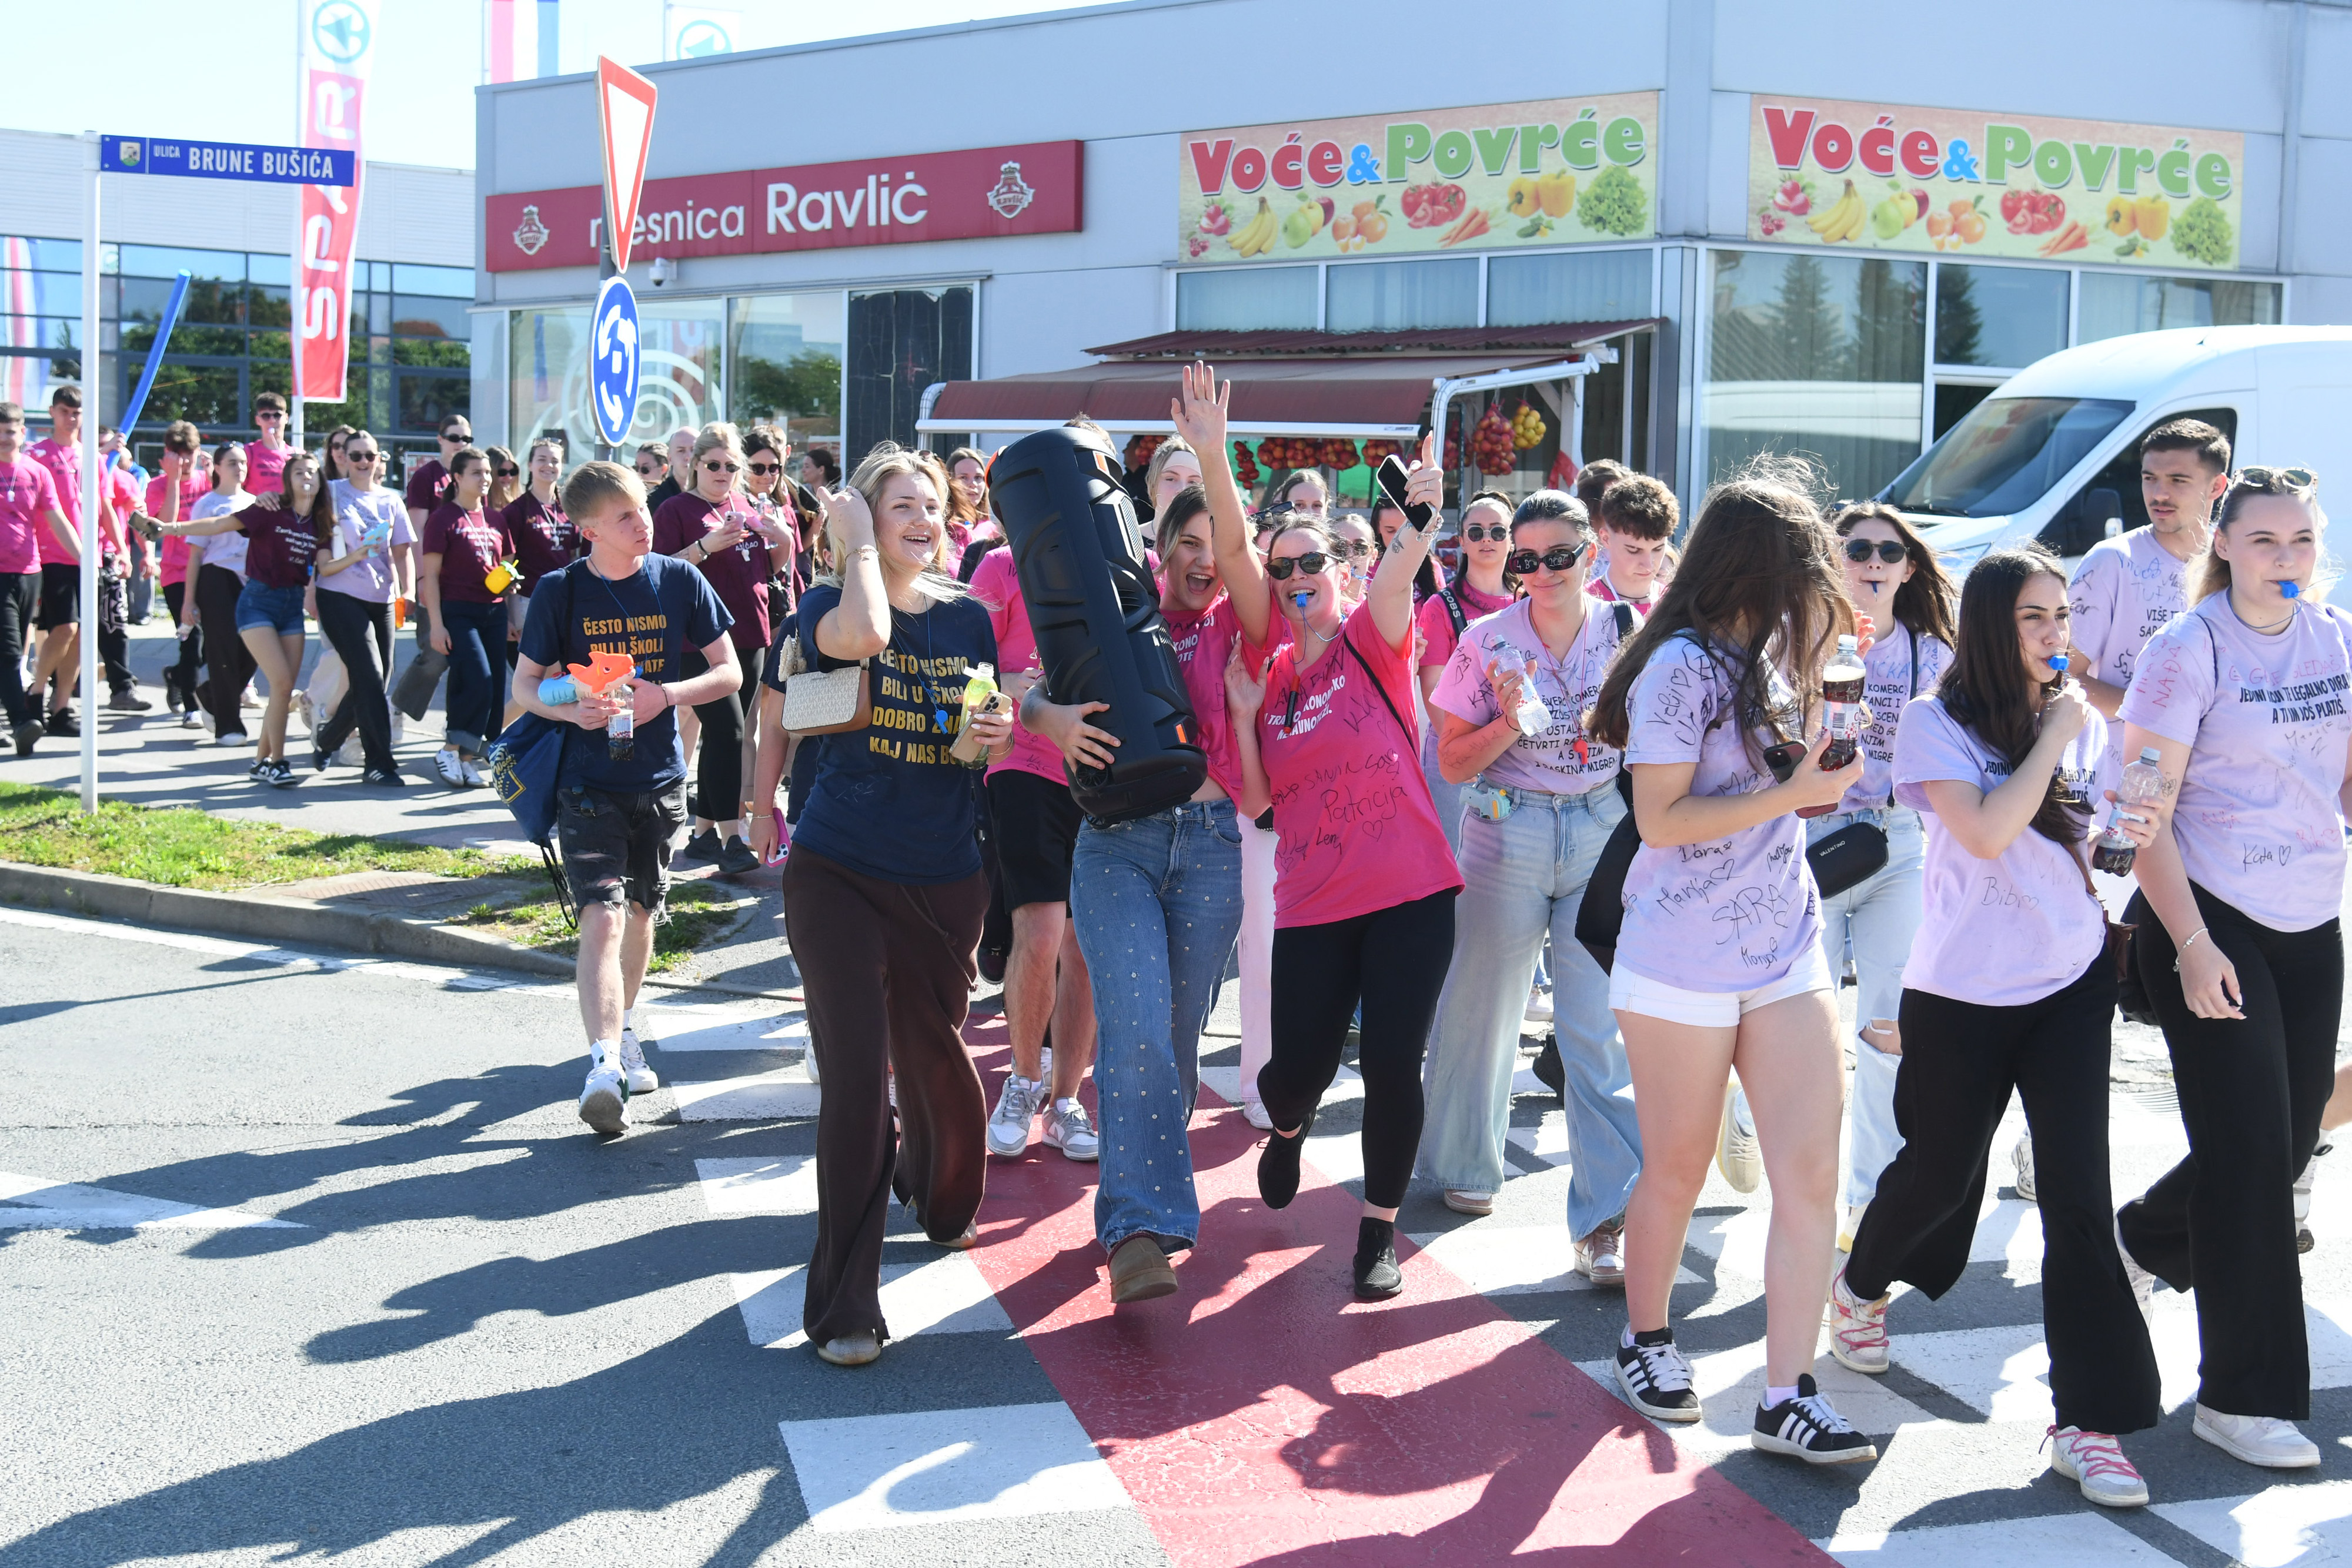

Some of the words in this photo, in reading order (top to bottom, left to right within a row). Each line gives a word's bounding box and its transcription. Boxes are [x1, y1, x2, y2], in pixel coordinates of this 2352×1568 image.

[153, 144, 181, 158] ULICA
[189, 147, 255, 173] BRUNE
[262, 149, 334, 179] BUŠIĆA
[301, 80, 356, 341] SPR
[1442, 589, 1461, 618] COBS
[2147, 606, 2167, 621] VIŠE
[583, 617, 623, 636] ČESTO
[626, 614, 667, 633] NISMO
[630, 636, 664, 656] ŠKOLI
[919, 656, 969, 677] NISMO
[881, 676, 908, 701] BILI
[911, 685, 923, 704] U
[2239, 687, 2267, 703] JEDINI
[2290, 680, 2328, 701] LEGALNO
[1895, 698, 1901, 708] I
[2272, 707, 2278, 724] A
[2280, 707, 2289, 724] TI
[2287, 707, 2300, 723] IM
[2298, 700, 2316, 722] JOŠ
[2314, 692, 2347, 719] PLATIŠ.
[872, 706, 926, 732] DOBRO
[931, 714, 962, 735] ZNA
[870, 735, 901, 759] KAJ
[906, 742, 936, 764] NAS
[1517, 735, 1560, 750] ČETVRTI
[1860, 733, 1885, 748] NJIM
[1558, 750, 1565, 760] A
[1568, 750, 1575, 760] S
[1586, 746, 1603, 758] JIM
[1984, 758, 2010, 776] JEDINI
[1320, 784, 1408, 823] Patricija
[1819, 840, 1846, 857] VALENTINO
[1712, 884, 1789, 945] SARA
